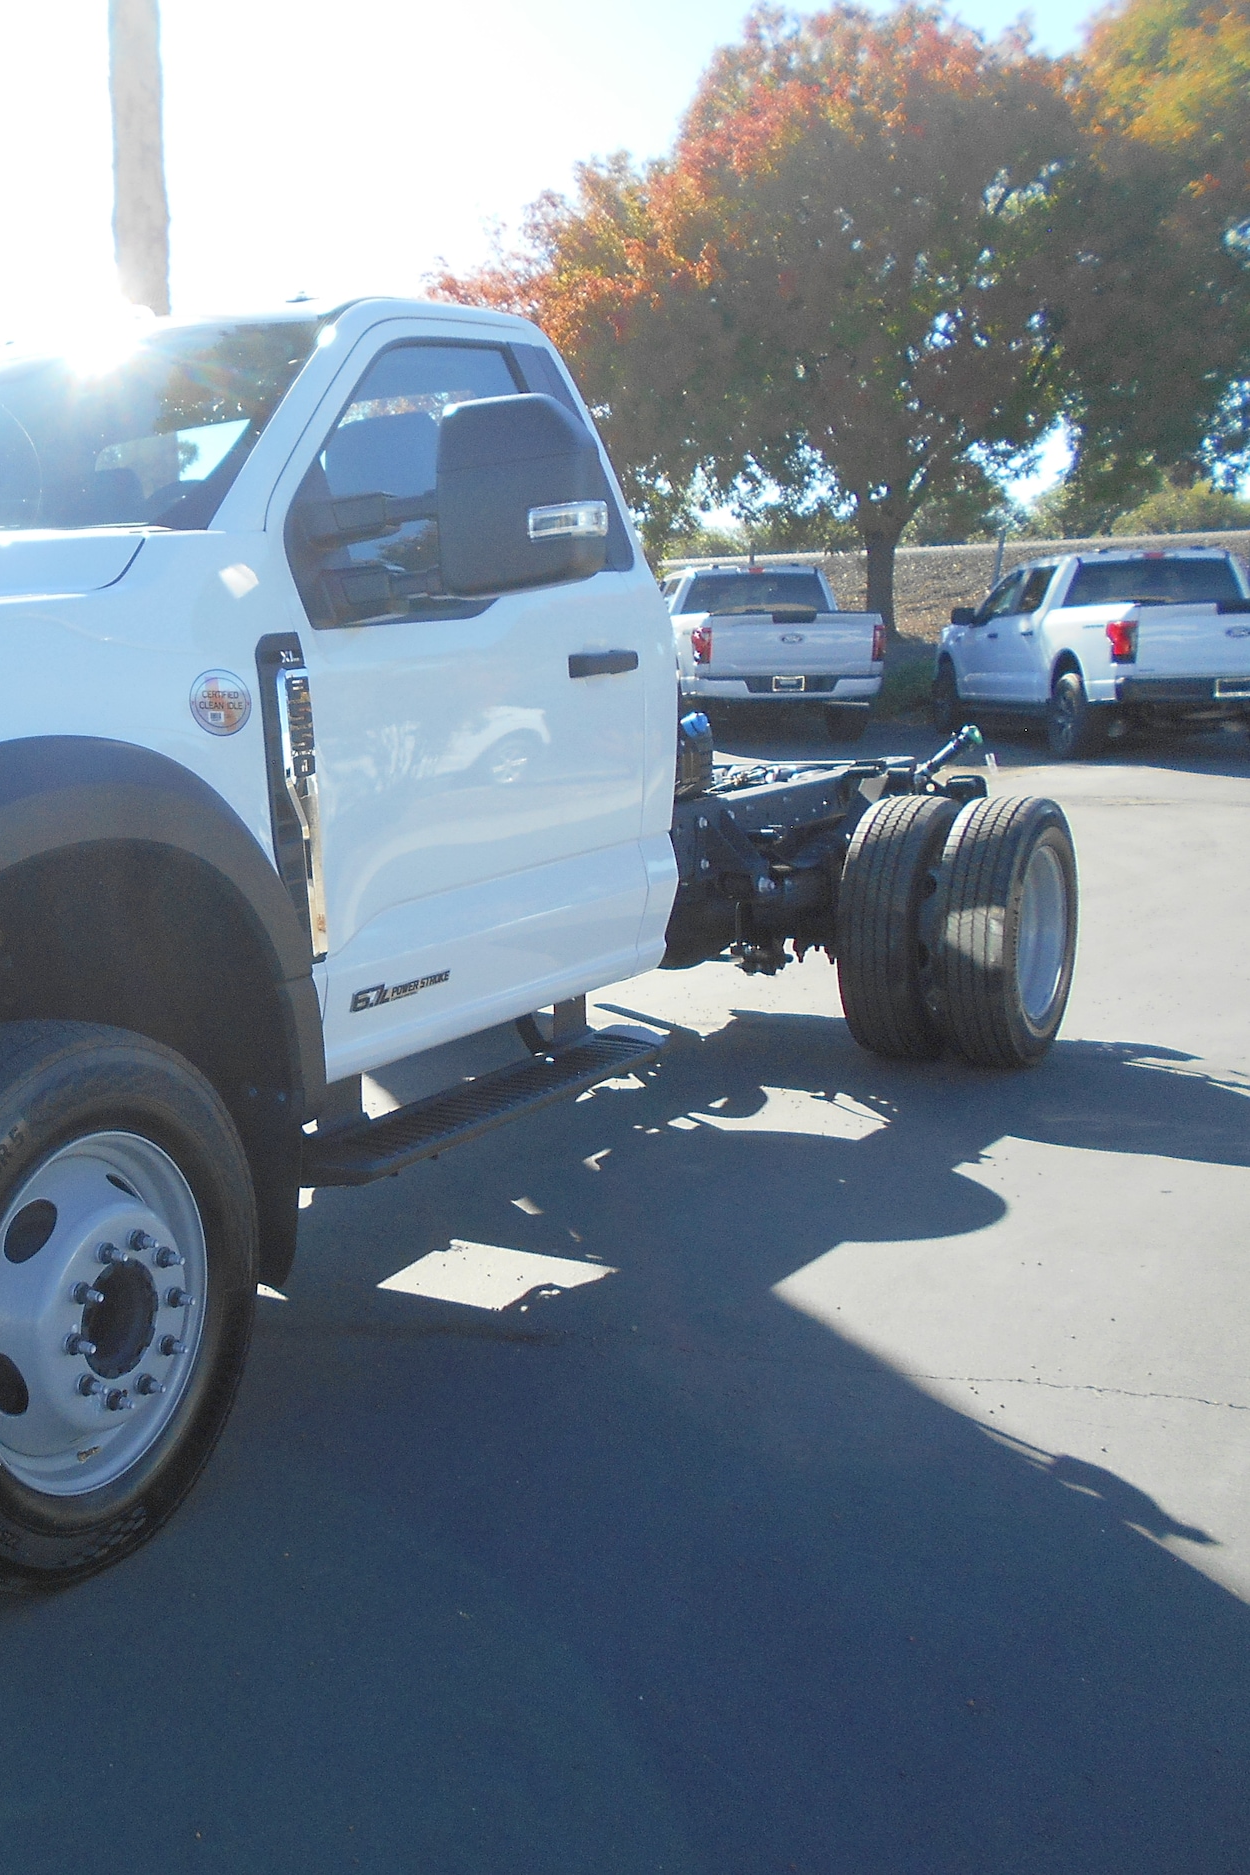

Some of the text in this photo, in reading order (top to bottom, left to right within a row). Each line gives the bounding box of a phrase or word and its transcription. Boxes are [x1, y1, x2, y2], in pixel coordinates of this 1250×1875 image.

[280, 650, 300, 663] XL
[201, 690, 239, 699] CERTIFIED
[199, 701, 224, 710] CLEAN
[391, 980, 419, 997] POWER
[419, 971, 450, 988] STROKE
